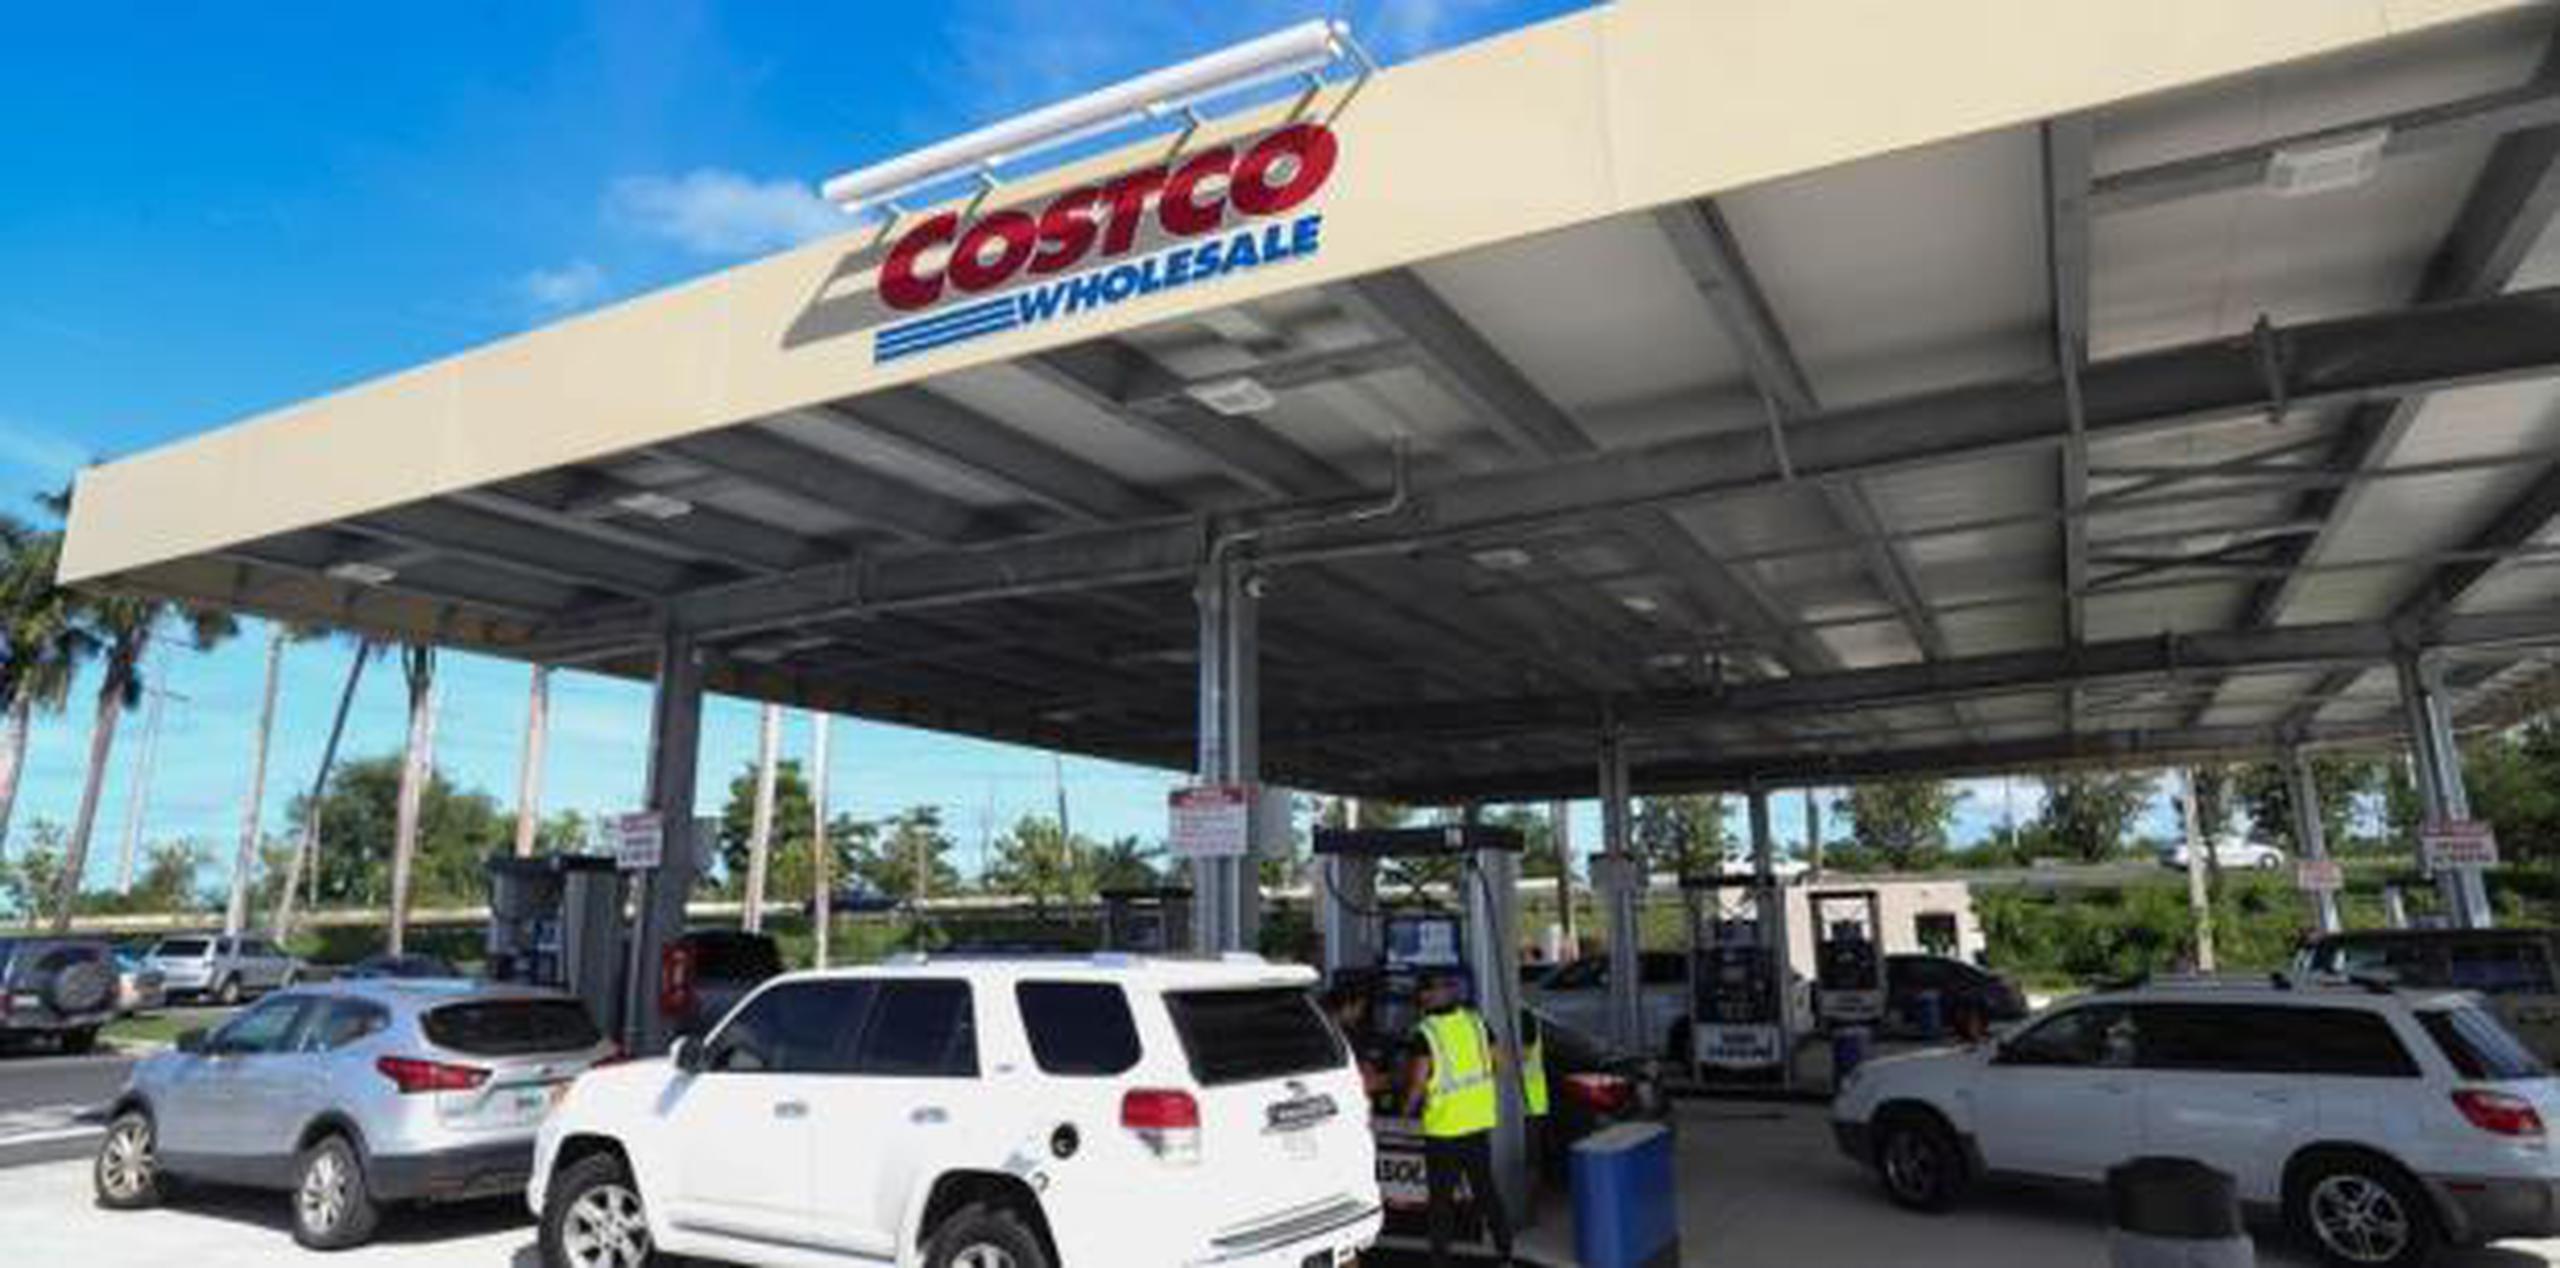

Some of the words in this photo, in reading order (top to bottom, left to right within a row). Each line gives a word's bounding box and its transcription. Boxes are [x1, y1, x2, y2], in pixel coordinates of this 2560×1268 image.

[878, 122, 1338, 311] COSTCO
[1018, 215, 1322, 325] WHOLESALE
[1376, 1159, 1426, 1184] SOL
